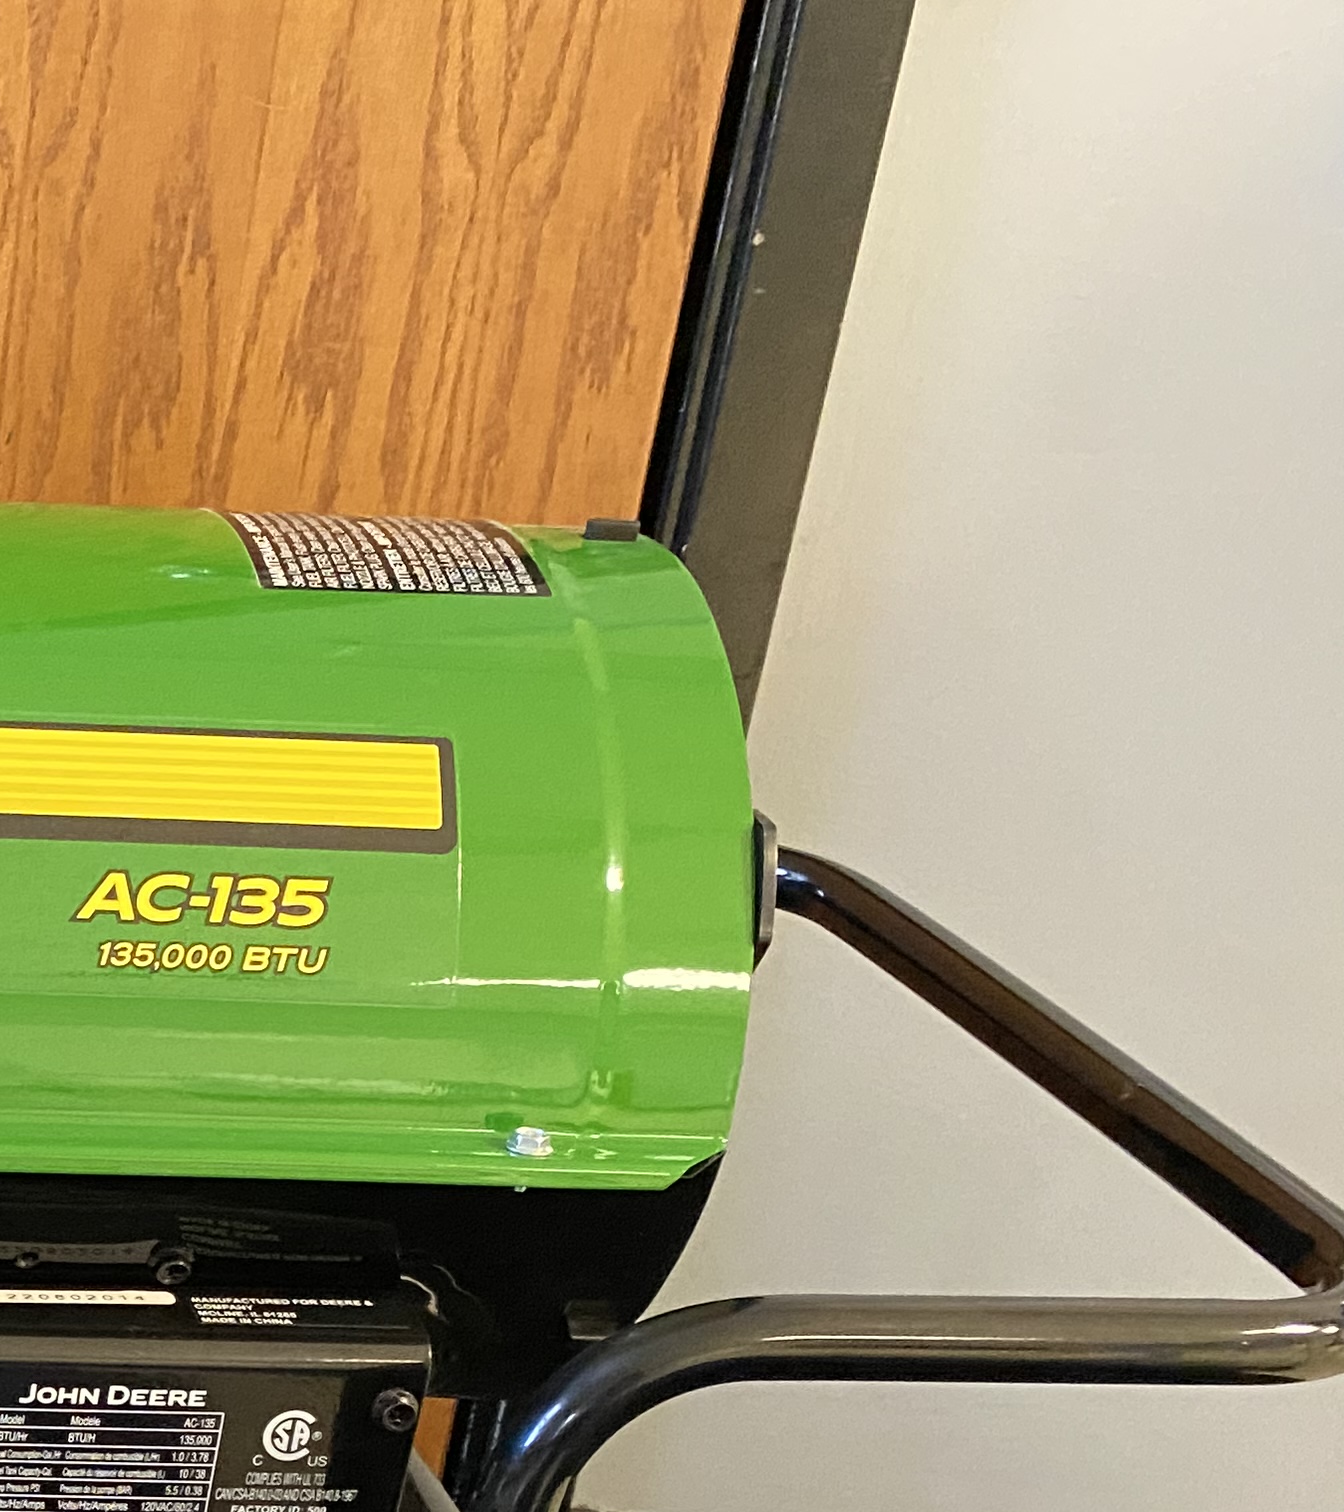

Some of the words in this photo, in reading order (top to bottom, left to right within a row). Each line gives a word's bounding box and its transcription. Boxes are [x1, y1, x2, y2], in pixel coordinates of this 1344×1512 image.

[70, 869, 333, 930] AC-135
[98, 941, 232, 973] 135,000
[240, 945, 331, 974] BTU
[191, 1297, 290, 1305] MANUFACTURED
[19, 1383, 100, 1405] JOHN
[107, 1385, 207, 1407] DEERE
[0, 1414, 25, 1425] Model
[184, 1418, 215, 1429] AC-135
[180, 1435, 212, 1446] 135,000
[307, 1455, 328, 1467] US
